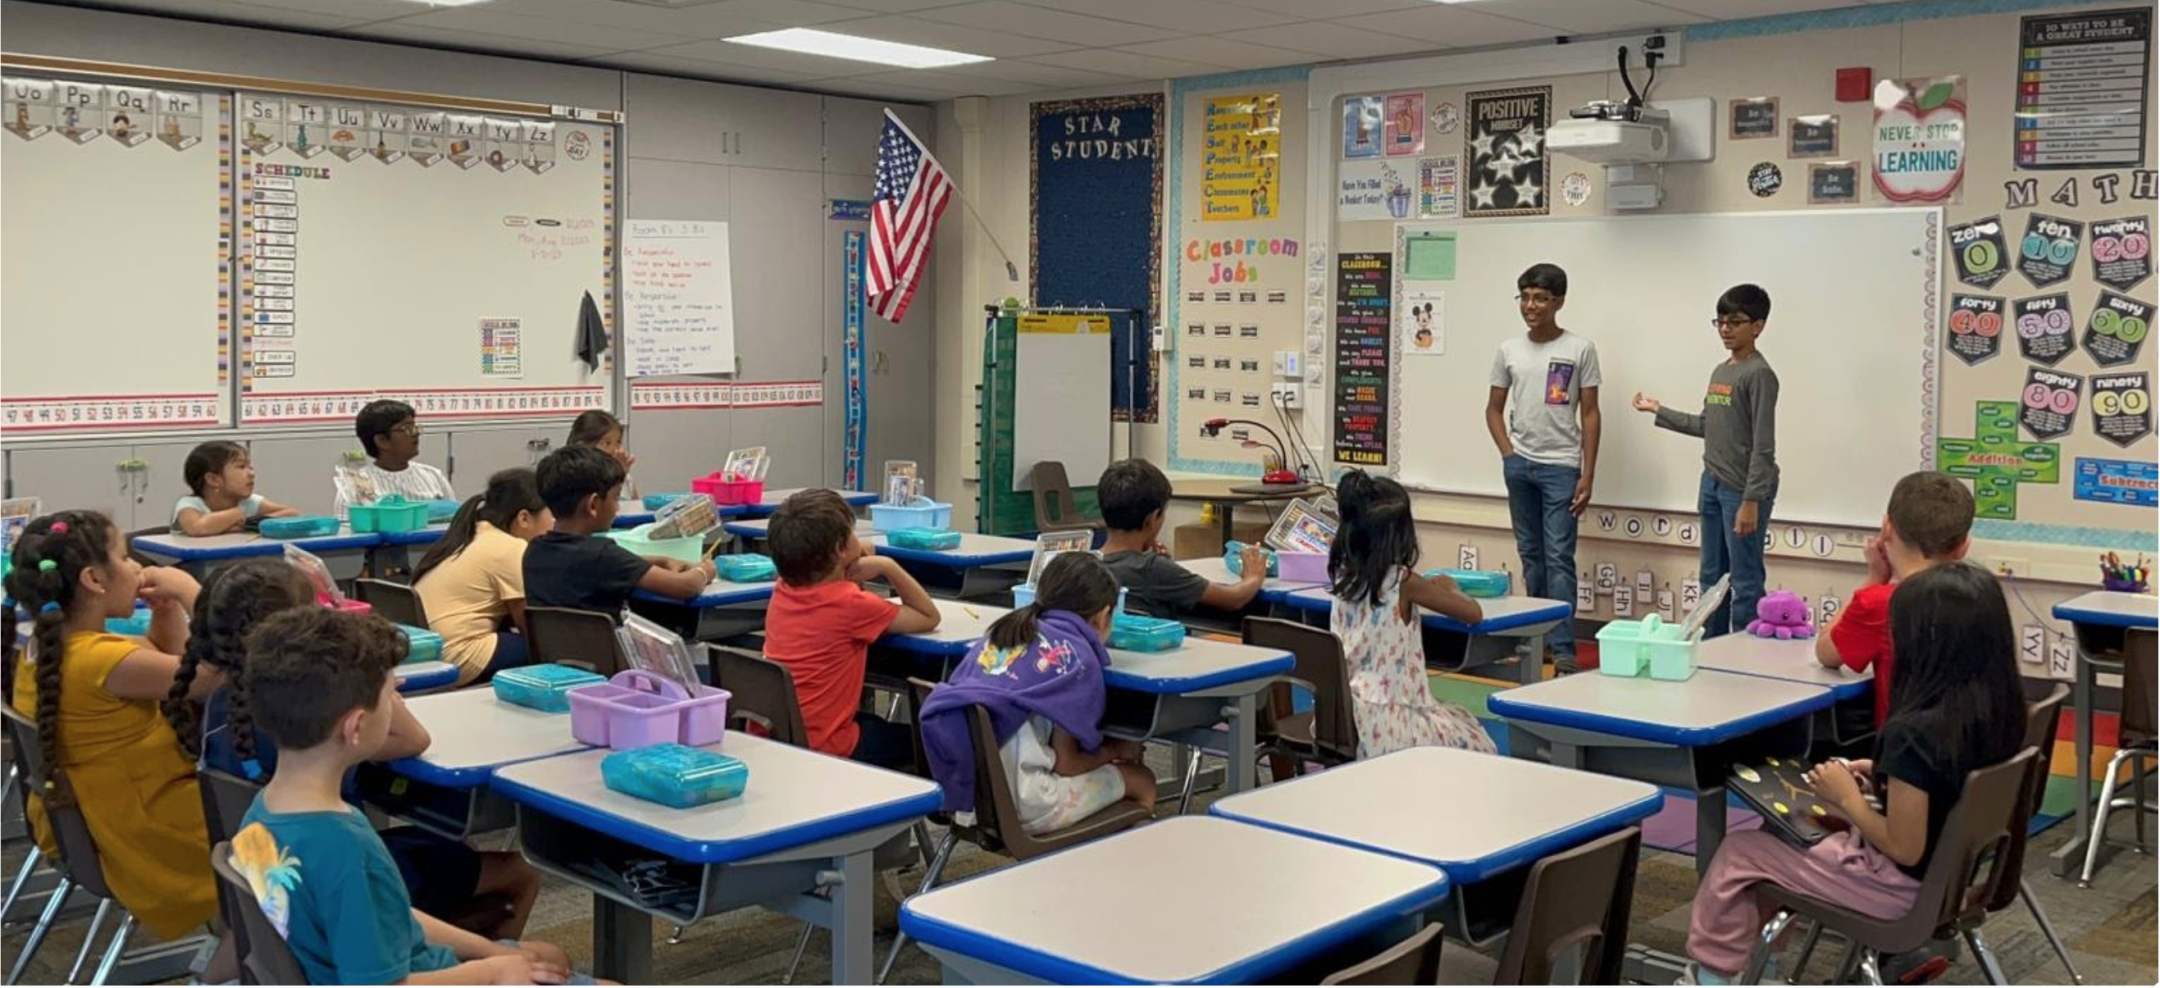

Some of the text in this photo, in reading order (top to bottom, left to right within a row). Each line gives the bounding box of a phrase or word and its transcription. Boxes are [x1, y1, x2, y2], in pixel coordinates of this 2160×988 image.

[2046, 30, 2082, 40] GREAT
[2084, 27, 2134, 37] STUDENT
[2061, 22, 2089, 31] WAYS
[2091, 20, 2107, 28] TO
[2110, 19, 2124, 27] BE
[67, 86, 90, 107] Pp
[117, 90, 145, 112] Qq
[169, 95, 191, 112] Rr
[252, 101, 272, 118] Ss
[298, 105, 316, 121] Tt
[338, 109, 358, 125] Uu
[1479, 97, 1538, 119] POSITIVE
[378, 112, 397, 128] Vv
[414, 117, 440, 132] Ww
[457, 122, 473, 135] Xx
[1065, 114, 1121, 136] STAR
[495, 126, 511, 141] Yy
[531, 127, 547, 141] Zz
[1880, 123, 1959, 141] NEVER STOP
[1051, 139, 1152, 160] STUDENT
[1879, 149, 1957, 173] LEARNING
[255, 163, 330, 179] SCHEDULE
[2005, 170, 2158, 209] MATH
[2037, 220, 2071, 238] ten
[2093, 220, 2145, 235] twenty
[1186, 239, 1299, 262] Classroom
[1968, 245, 1988, 266] 0
[2033, 240, 2067, 259] 10
[2103, 236, 2140, 257] 20
[1208, 260, 1258, 284] Jobs
[1960, 298, 1997, 311] forty
[2026, 297, 2056, 311] fifty
[2110, 298, 2144, 315] sixty
[1960, 313, 1994, 330] 40
[2024, 311, 2062, 334] 50
[2095, 311, 2137, 336] 60
[2034, 371, 2077, 389] eighty
[2096, 376, 2142, 388] ninety
[2031, 385, 2069, 408] 80
[2103, 391, 2140, 414] 90
[1339, 450, 1383, 463] WE LEARN!
[1968, 454, 2022, 466] Addition
[1599, 515, 1692, 540] word
[1598, 566, 1614, 588] Gg
[1579, 587, 1592, 604] Ff
[1616, 590, 1629, 611] Hh
[1684, 585, 1698, 602] Kk
[2023, 633, 2041, 656] Yy
[2053, 648, 2070, 672] Zz
